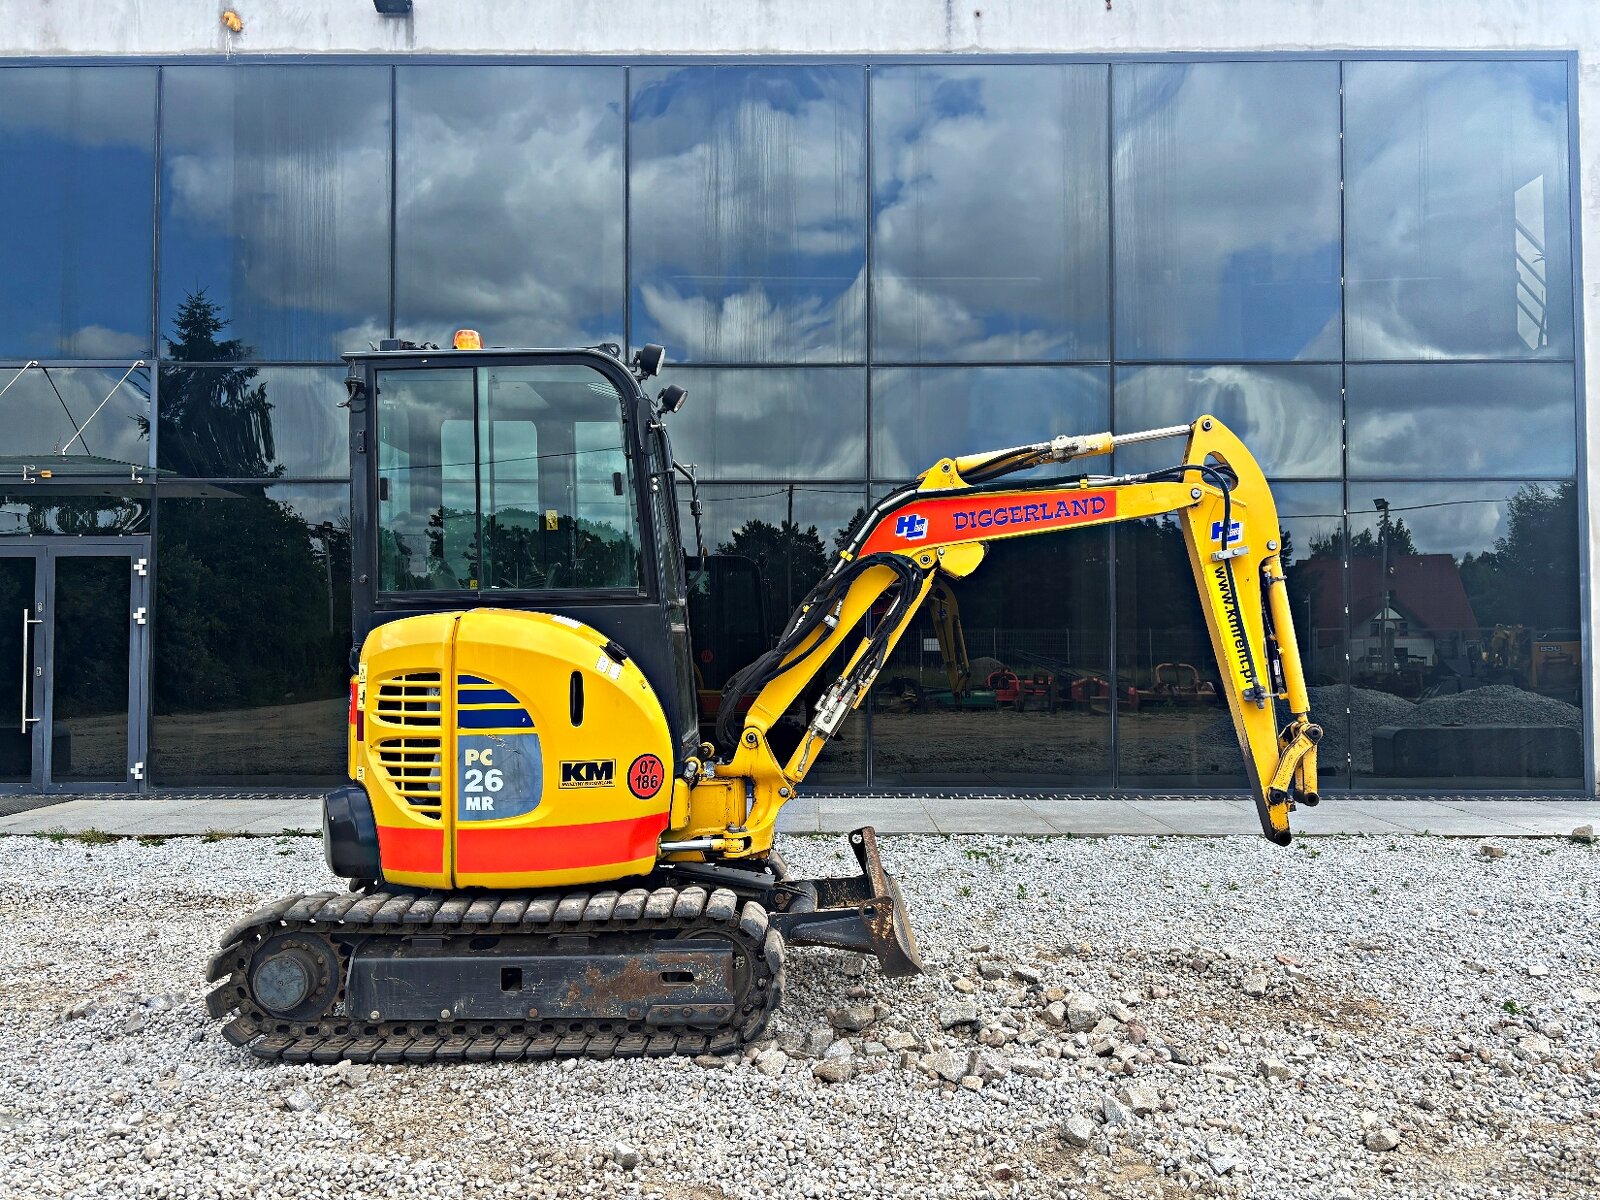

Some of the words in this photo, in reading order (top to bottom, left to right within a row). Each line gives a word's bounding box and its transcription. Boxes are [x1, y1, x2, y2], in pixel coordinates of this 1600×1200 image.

[953, 497, 1106, 530] DIGGERLAND
[464, 748, 493, 766] PC
[562, 762, 613, 781] KM
[639, 760, 655, 774] 07
[464, 769, 504, 793] 26
[635, 775, 658, 789] 186
[465, 797, 495, 811] MR
